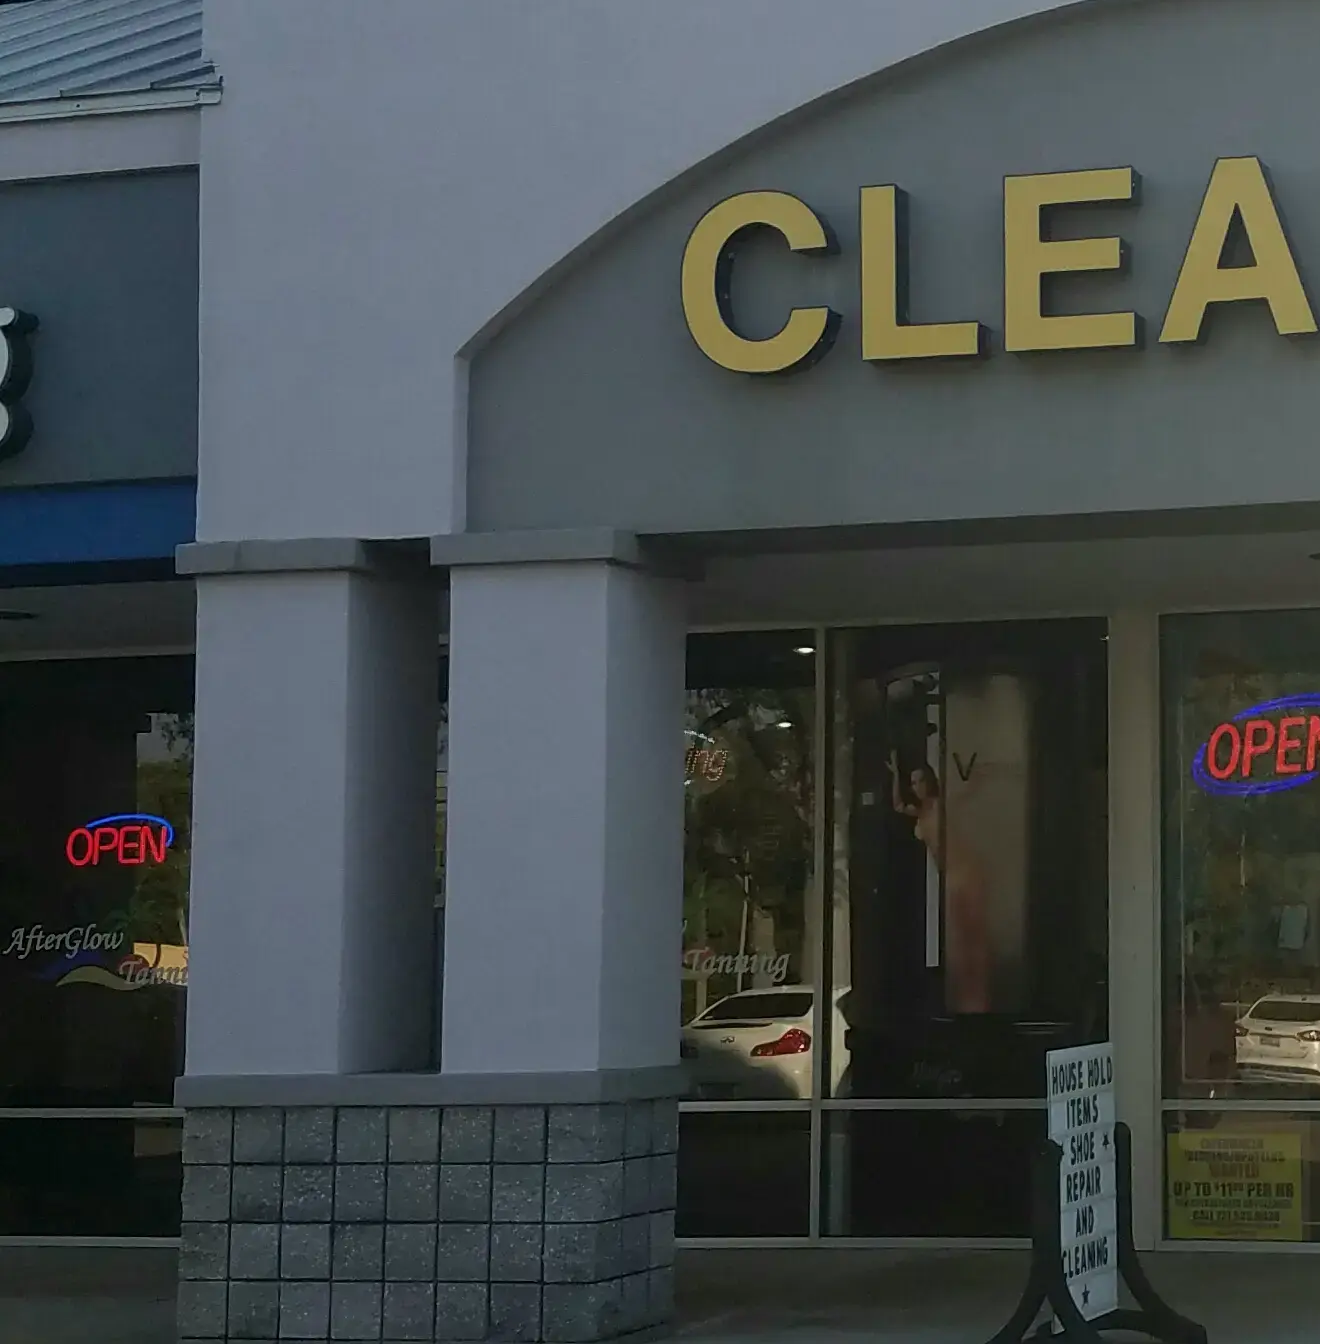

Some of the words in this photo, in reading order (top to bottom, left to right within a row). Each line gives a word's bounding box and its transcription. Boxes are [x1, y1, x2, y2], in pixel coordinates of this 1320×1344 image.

[66, 826, 168, 867] OPEN
[3, 923, 124, 960] AfterGlow
[684, 949, 791, 983] Tanning
[1051, 1060, 1084, 1096] HOUSE
[1087, 1056, 1113, 1088] HOLD
[1066, 1094, 1099, 1129] ITEMS
[1070, 1131, 1096, 1166] SHOE
[1066, 1165, 1102, 1204] REPAIR
[1173, 1181, 1192, 1197] UP
[1194, 1181, 1212, 1197] TO
[1246, 1181, 1272, 1197] PER
[1275, 1181, 1294, 1198] HR
[1075, 1205, 1095, 1238] AND
[1061, 1236, 1108, 1278] CLEANING
